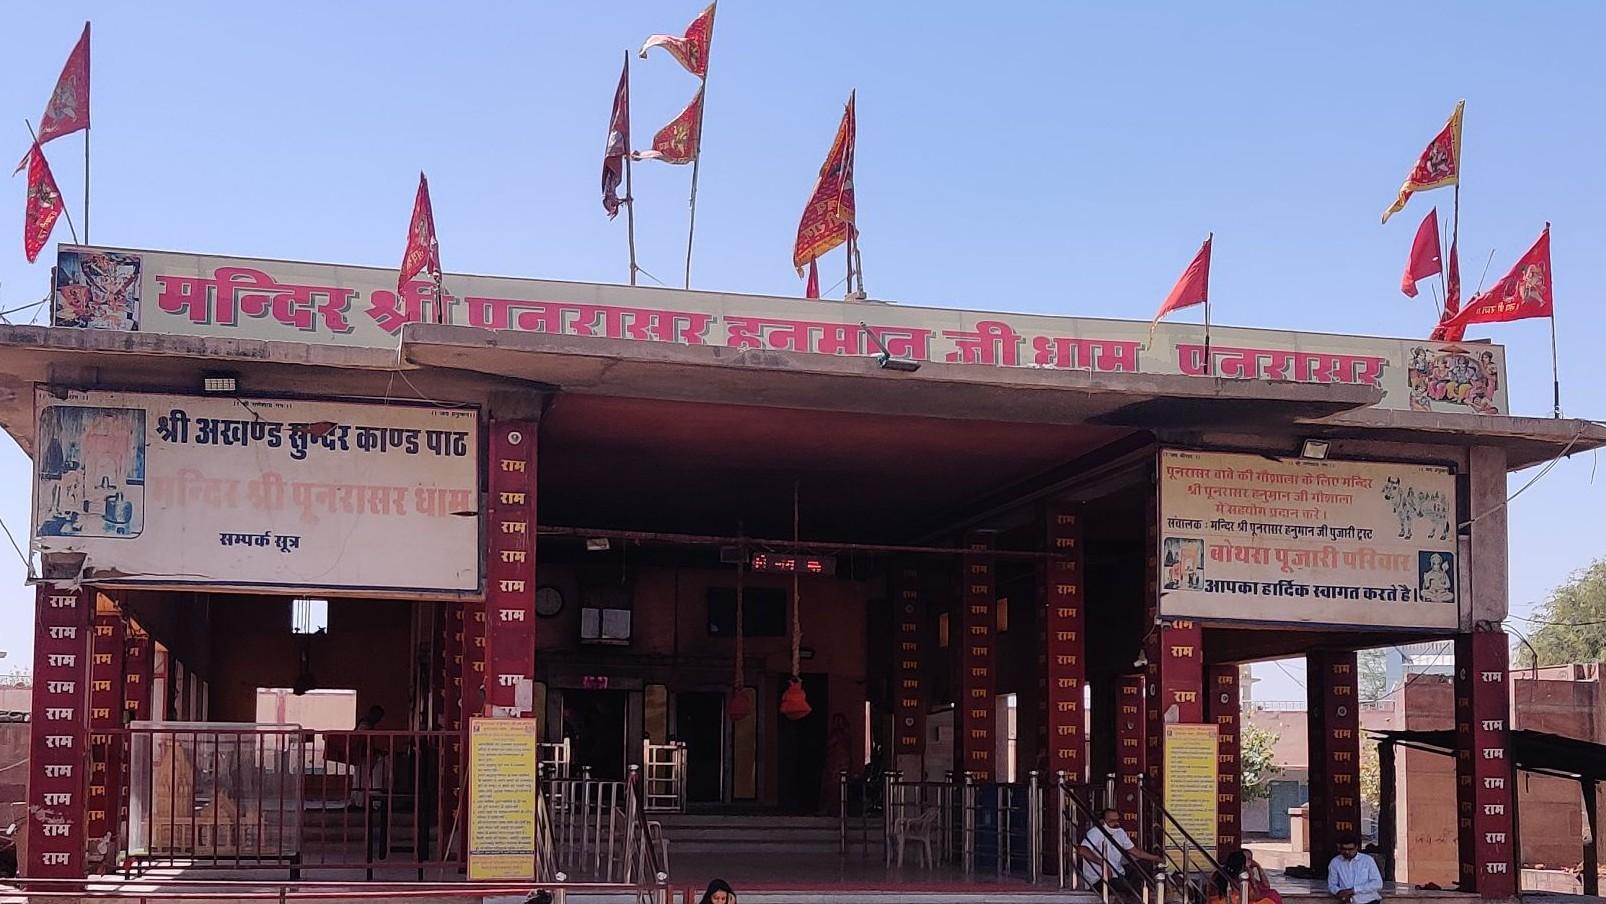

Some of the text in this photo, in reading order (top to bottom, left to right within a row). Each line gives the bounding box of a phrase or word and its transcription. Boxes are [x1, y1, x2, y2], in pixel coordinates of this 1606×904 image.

[155, 267, 357, 332] मन्दिर
[364, 279, 456, 333] श्री
[942, 320, 1022, 365] जी
[1032, 335, 1142, 372] धाम
[156, 409, 191, 443] श्री
[195, 418, 282, 448] अखण्ड
[355, 425, 421, 455] काण्ड
[426, 429, 469, 457] पाठ
[500, 460, 526, 472] राम
[1167, 466, 1210, 480] पूनरासर
[1238, 469, 1253, 482] की
[1302, 473, 1314, 486] के
[1317, 473, 1341, 487] लिए
[1342, 475, 1374, 488] मन्दिर
[150, 468, 473, 525] मन्दिर श्री पूनरासर धाम
[1186, 483, 1201, 496] श्री
[1204, 485, 1249, 500] पूनरासर
[1252, 488, 1291, 503] हनुमान
[1293, 489, 1309, 502] जी
[500, 493, 525, 505] राम
[1057, 515, 1075, 525] राम
[501, 521, 526, 533] राम
[1210, 519, 1235, 532] मन्दिर
[1237, 520, 1247, 533] श्री
[1249, 522, 1283, 537] पूनरासर
[1284, 524, 1315, 539] हनुमान
[1317, 522, 1328, 537] जी
[1330, 525, 1355, 541] पुजारी
[219, 531, 301, 553] सम्पर्क सूत्र
[1056, 538, 1075, 548] राम
[500, 550, 525, 562] राम
[1343, 547, 1411, 572] परिवार
[499, 579, 525, 592] राम
[1057, 585, 1076, 595] राम
[1204, 580, 1259, 595] आपका
[1261, 580, 1310, 598] हार्दिक
[1313, 586, 1360, 601] स्वागत
[1362, 584, 1397, 602] करते
[50, 596, 77, 607] राम
[499, 609, 525, 622] राम
[1057, 608, 1076, 618] राम
[50, 626, 76, 638] राम
[1057, 631, 1076, 641] राम
[1171, 646, 1193, 657] राम
[48, 654, 76, 666] राम
[1057, 655, 1076, 665] राम
[1333, 665, 1350, 673] राम
[1218, 676, 1233, 685] राम
[1481, 672, 1502, 682] राम
[48, 681, 75, 693] राम
[1058, 678, 1077, 688] राम
[1333, 686, 1350, 695] राम
[1174, 692, 1196, 703] राम
[1058, 702, 1076, 712] राम
[1123, 705, 1137, 713] राम
[46, 708, 74, 720] राम
[1218, 716, 1233, 724] राम
[1482, 720, 1502, 730] राम
[1058, 725, 1076, 735] राम
[1334, 729, 1351, 738] राम
[46, 735, 73, 747] राम
[1123, 739, 1137, 747] राम
[1219, 735, 1233, 744] राम
[1059, 749, 1076, 759] राम
[1218, 754, 1233, 763] राम
[1334, 752, 1351, 760] राम
[1483, 749, 1503, 759] राम
[1123, 757, 1137, 765] राम
[45, 765, 72, 776] राम
[1123, 775, 1137, 784] राम
[1219, 774, 1233, 783] राम
[1334, 775, 1351, 784] राम
[1484, 778, 1504, 788] राम
[44, 793, 71, 805] राम
[1219, 793, 1233, 803] राम
[1336, 797, 1352, 806] राम
[1484, 805, 1504, 815] राम
[1123, 813, 1137, 821] राम
[1219, 814, 1234, 823] राम
[43, 823, 70, 835] राम
[1336, 822, 1352, 831] राम
[1219, 835, 1234, 844] राम
[1485, 833, 1506, 843] राम
[42, 853, 70, 864] राम
[1486, 863, 1507, 873] राम
